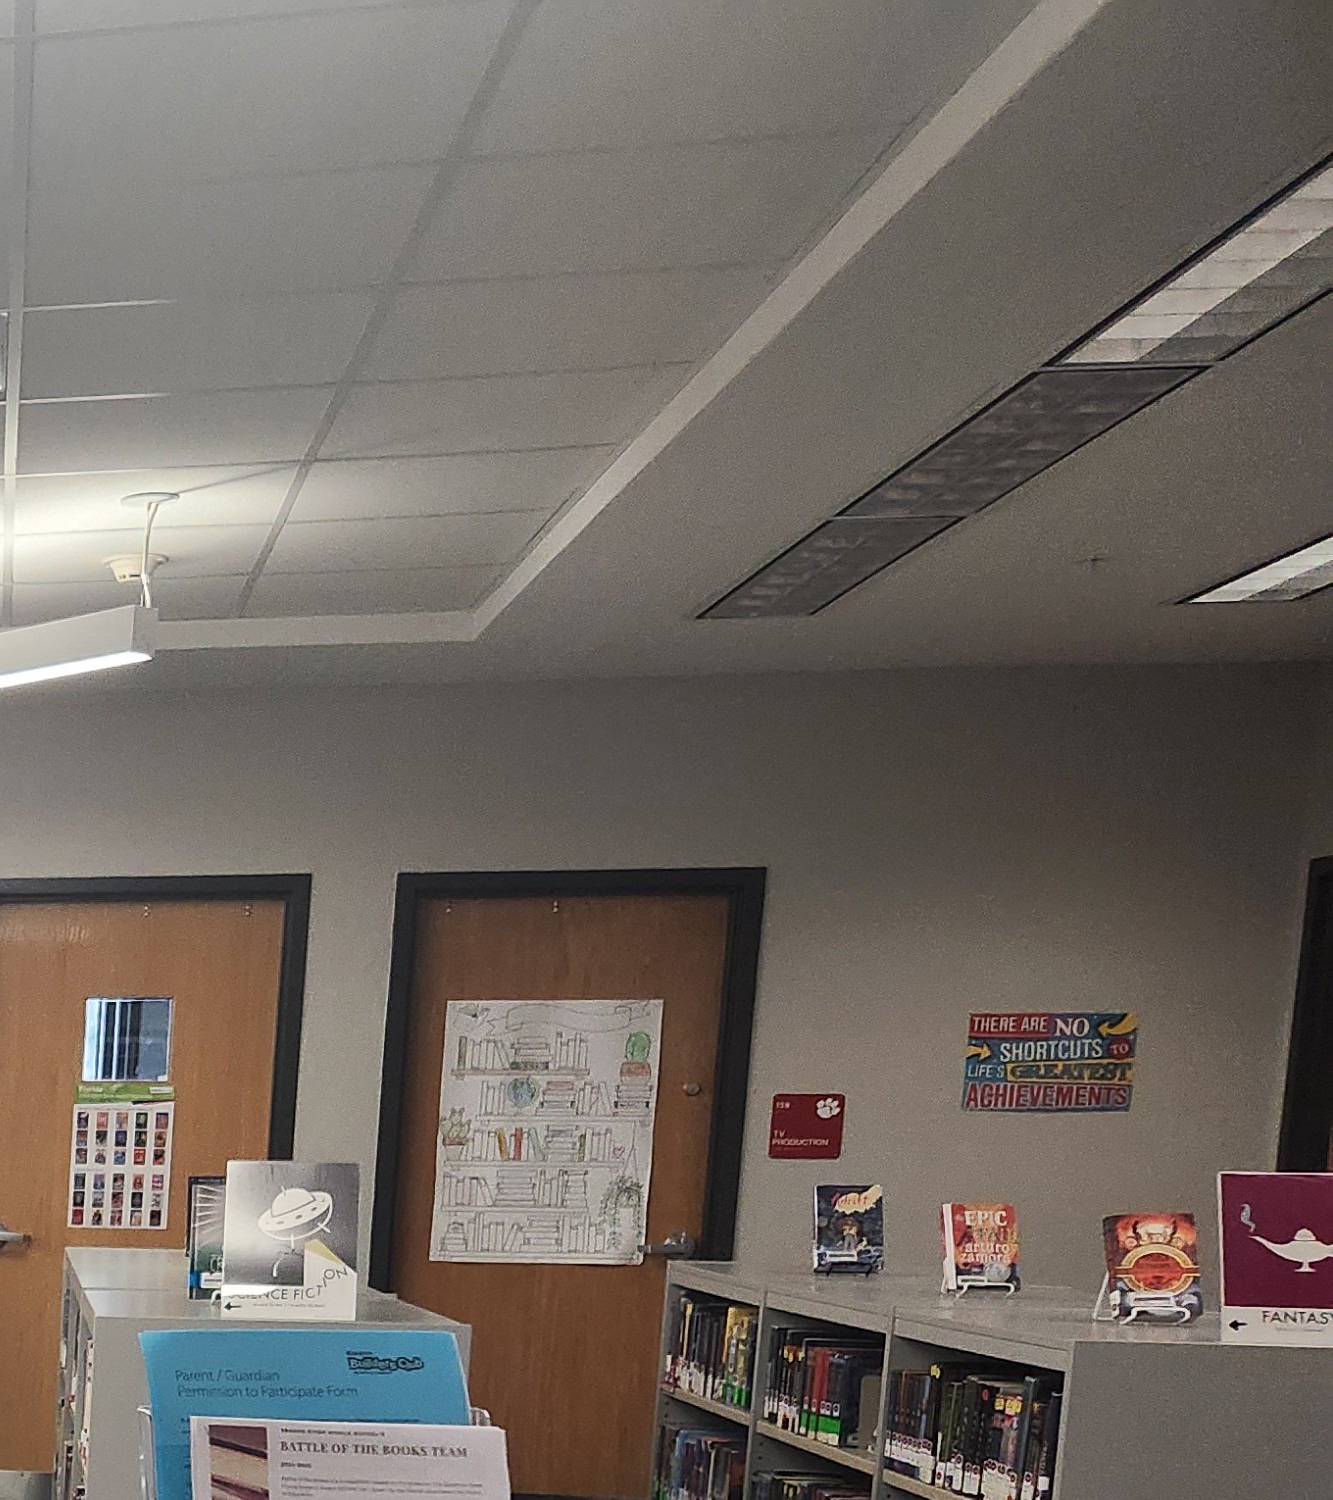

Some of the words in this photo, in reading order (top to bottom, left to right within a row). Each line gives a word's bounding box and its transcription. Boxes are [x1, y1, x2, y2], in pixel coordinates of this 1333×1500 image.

[972, 1016, 1017, 1033] THERE
[1021, 1016, 1048, 1032] ARE
[1054, 1018, 1090, 1037] NO
[1000, 1039, 1103, 1062] SHORTCUTS
[1110, 1044, 1129, 1054] TO
[967, 1064, 1005, 1078] LIFE'S
[1009, 1063, 1132, 1082] GREATEST
[965, 1082, 1130, 1110] ACHIEVEMENTS
[771, 1138, 830, 1146] PRODUCTION
[964, 1210, 1008, 1226] EPIC
[965, 1242, 1010, 1254] arturo
[293, 1267, 348, 1301] FICTION
[175, 1369, 214, 1382] Parent
[225, 1369, 280, 1382] Guardian
[177, 1385, 243, 1398] Permission
[245, 1387, 259, 1397] to
[261, 1386, 324, 1400] Participate
[327, 1386, 359, 1397] Form
[280, 1440, 329, 1453] BATTLE
[332, 1443, 349, 1454] OF
[352, 1444, 379, 1456] THE
[382, 1445, 428, 1457] BOOKS
[432, 1446, 469, 1458] TEAM
